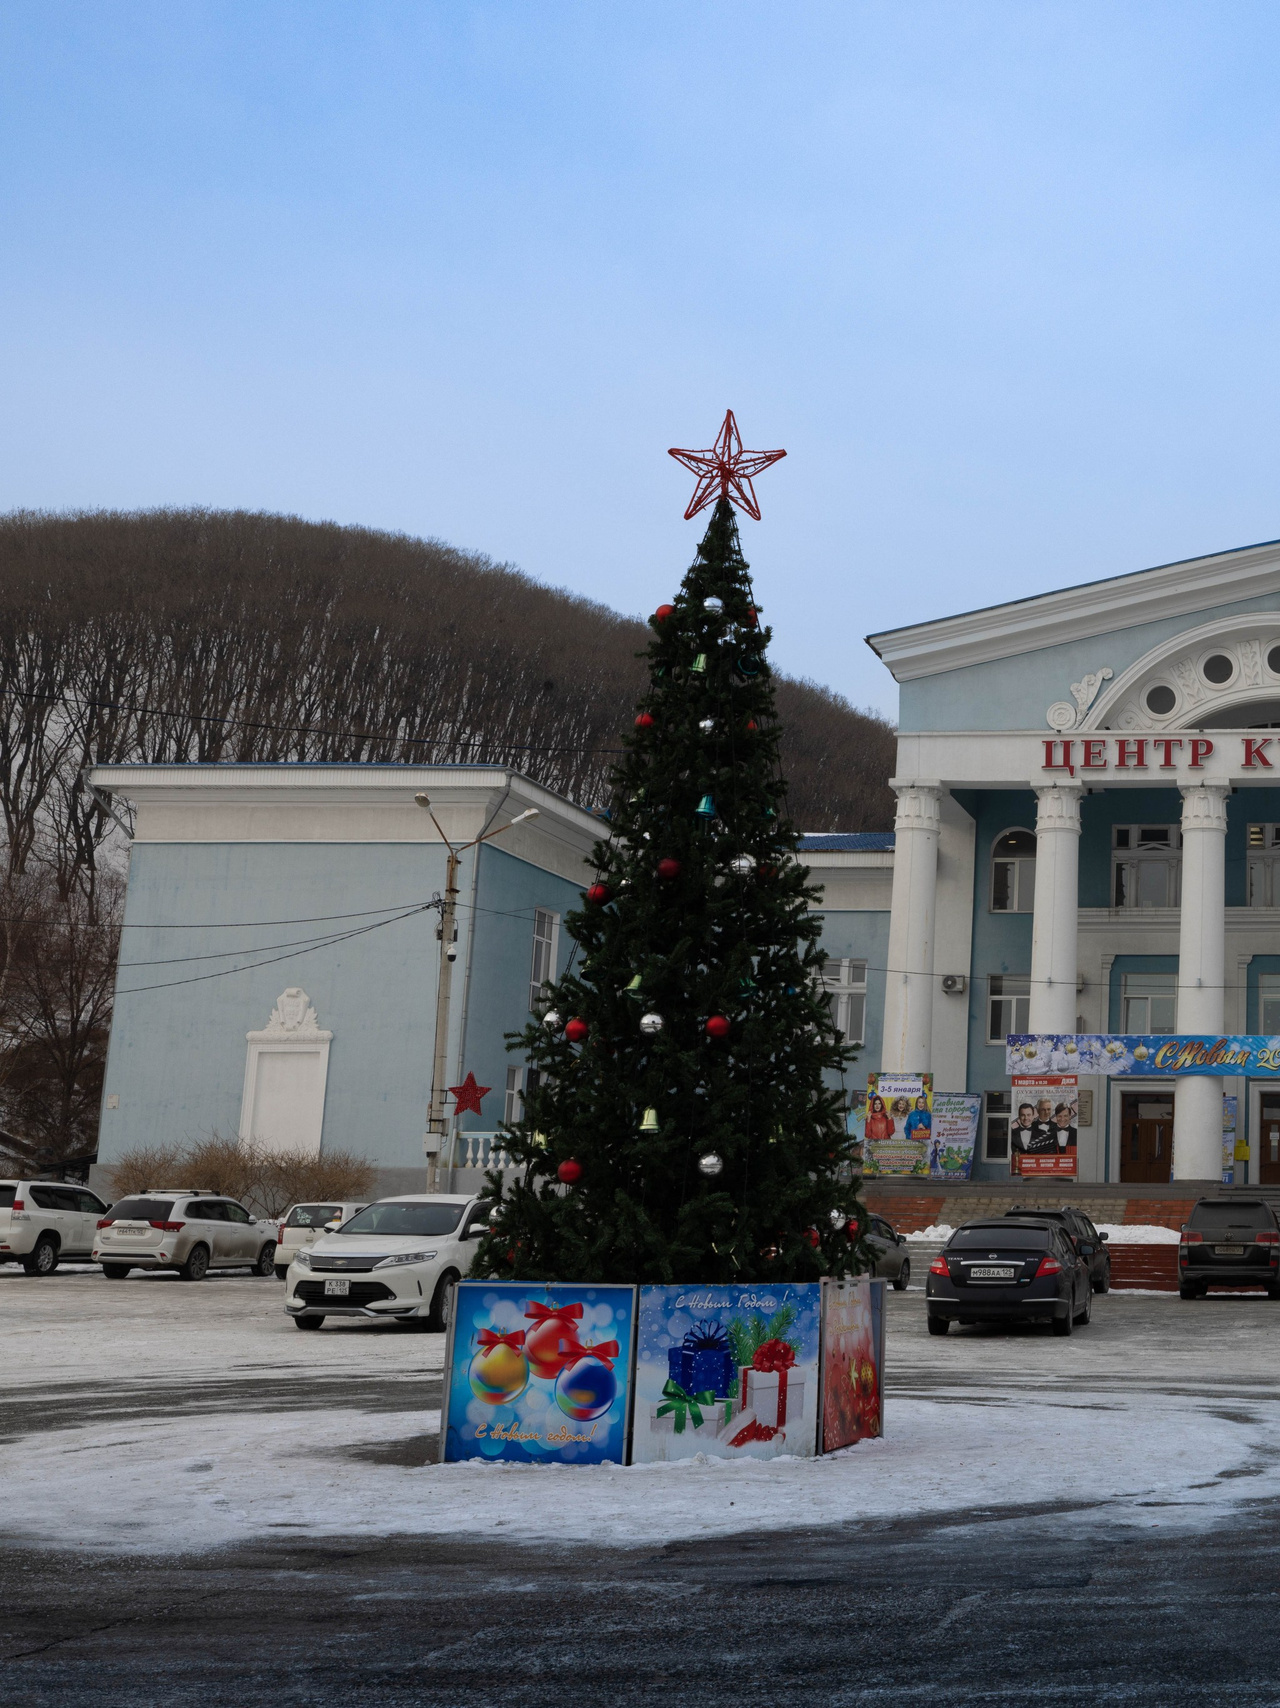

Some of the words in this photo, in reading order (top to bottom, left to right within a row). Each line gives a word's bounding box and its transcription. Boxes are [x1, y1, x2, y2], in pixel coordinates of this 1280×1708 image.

[1041, 738, 1214, 777] ЦЕНТР
[1172, 1038, 1251, 1070] Новым
[880, 1085, 892, 1093] 3-5
[675, 1295, 686, 1309] С
[688, 1293, 734, 1309] Новым
[736, 1294, 777, 1309] Годом
[475, 1423, 487, 1438] С
[490, 1422, 542, 1441] Новым
[547, 1423, 598, 1442] годом!
